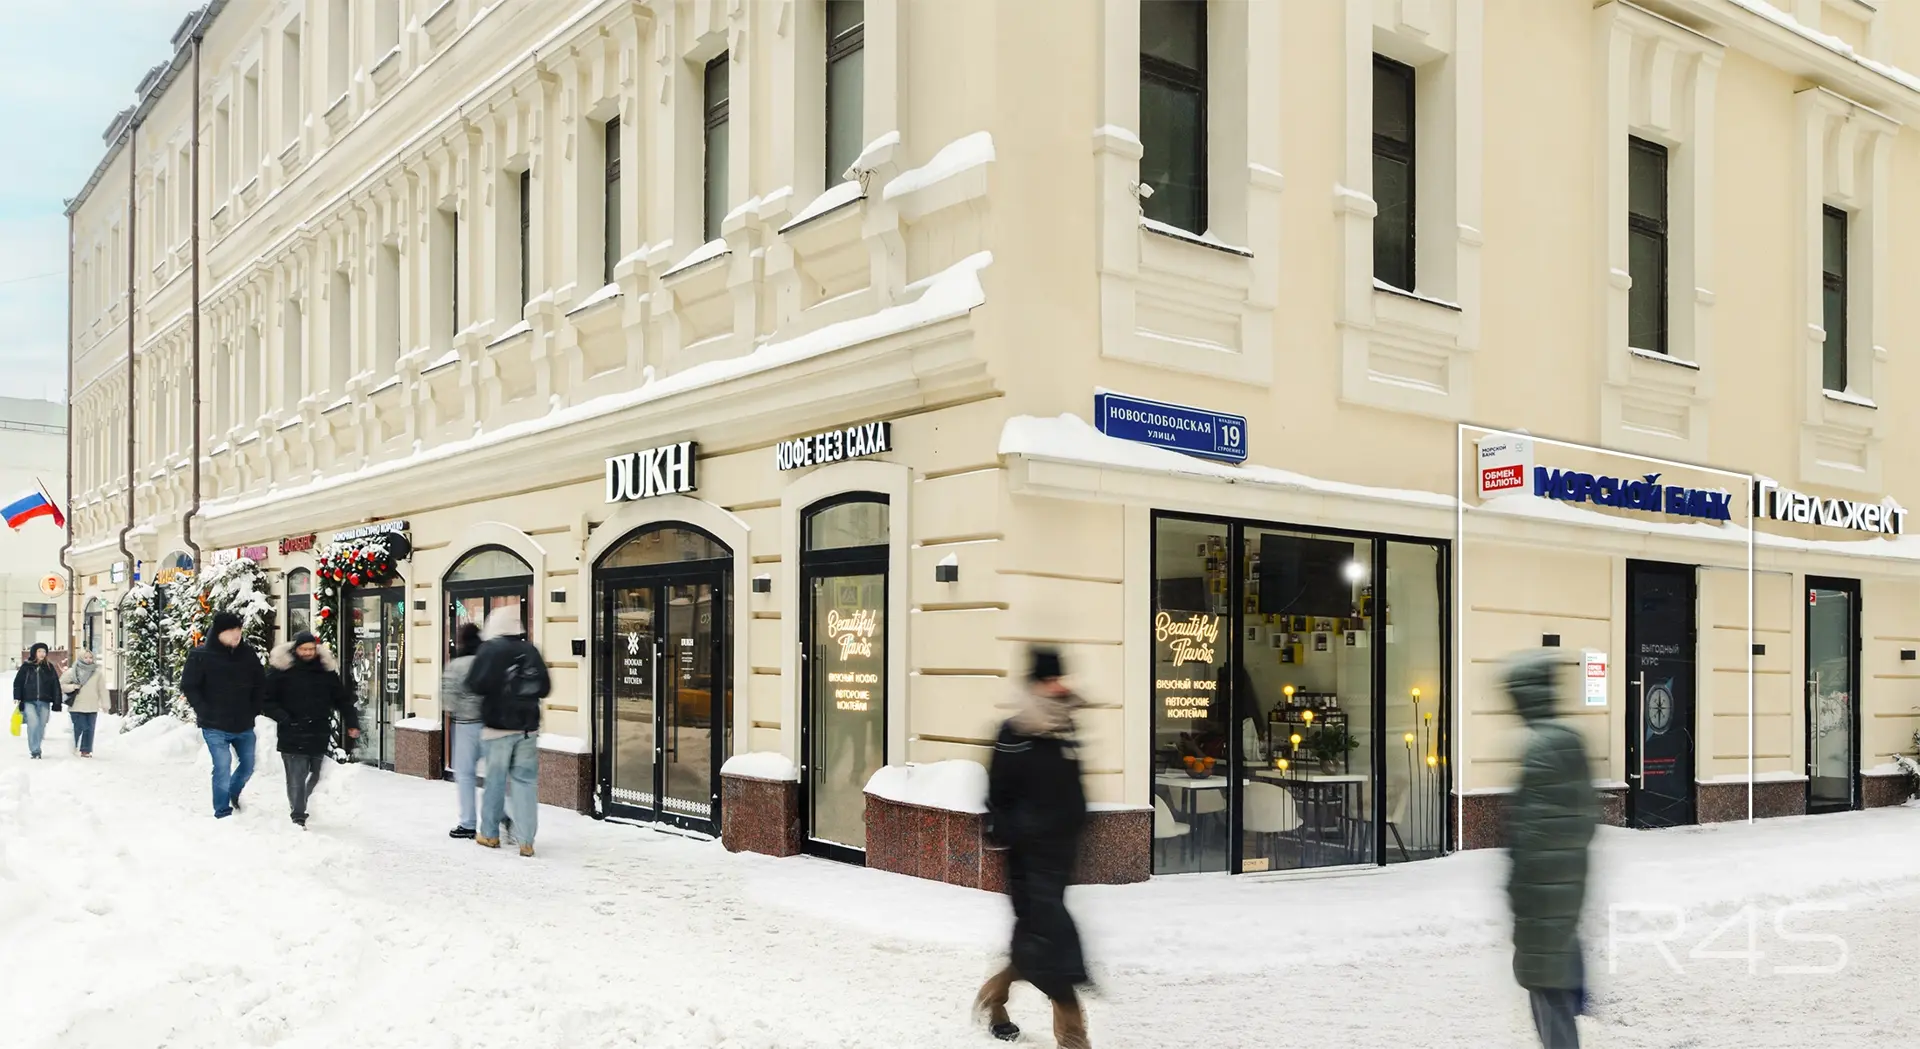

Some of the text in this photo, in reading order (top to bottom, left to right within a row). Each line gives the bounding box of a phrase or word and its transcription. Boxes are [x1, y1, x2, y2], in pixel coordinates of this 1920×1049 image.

[1110, 407, 1211, 434] НОВОСЛОБОДСКАЯ
[1147, 430, 1176, 442] УЛИЦА
[1221, 425, 1241, 448] 19
[776, 421, 890, 471] КОФЕ БЕЗ САХА
[1481, 445, 1507, 453] МОРСКОЙ
[604, 441, 697, 504] DUKH
[1484, 469, 1515, 481] ОБМЕН
[1484, 477, 1522, 489] ВАЛЮТЫ
[1533, 466, 1732, 521] МОРСКОЙ БАНК
[1754, 479, 1907, 534] Гиалджект
[827, 609, 876, 638] Beautiful
[1155, 612, 1220, 643] Beautiful
[837, 633, 872, 661] Flavors
[1169, 638, 1215, 667] Flavors
[1641, 643, 1679, 655] ВЫГОДНЫЙ
[624, 658, 643, 667] HOOKAH
[1641, 657, 1659, 666] КУРС
[629, 668, 638, 676] BAR
[828, 672, 855, 683] ВКУСНЫЙ
[624, 677, 643, 686] KITCHEN
[1156, 678, 1217, 690] ВКУСНЫЙ КОФЕ
[1165, 696, 1210, 707] АВТОРСКИЕ
[1167, 708, 1208, 719] КОКТЕЙЛИ
